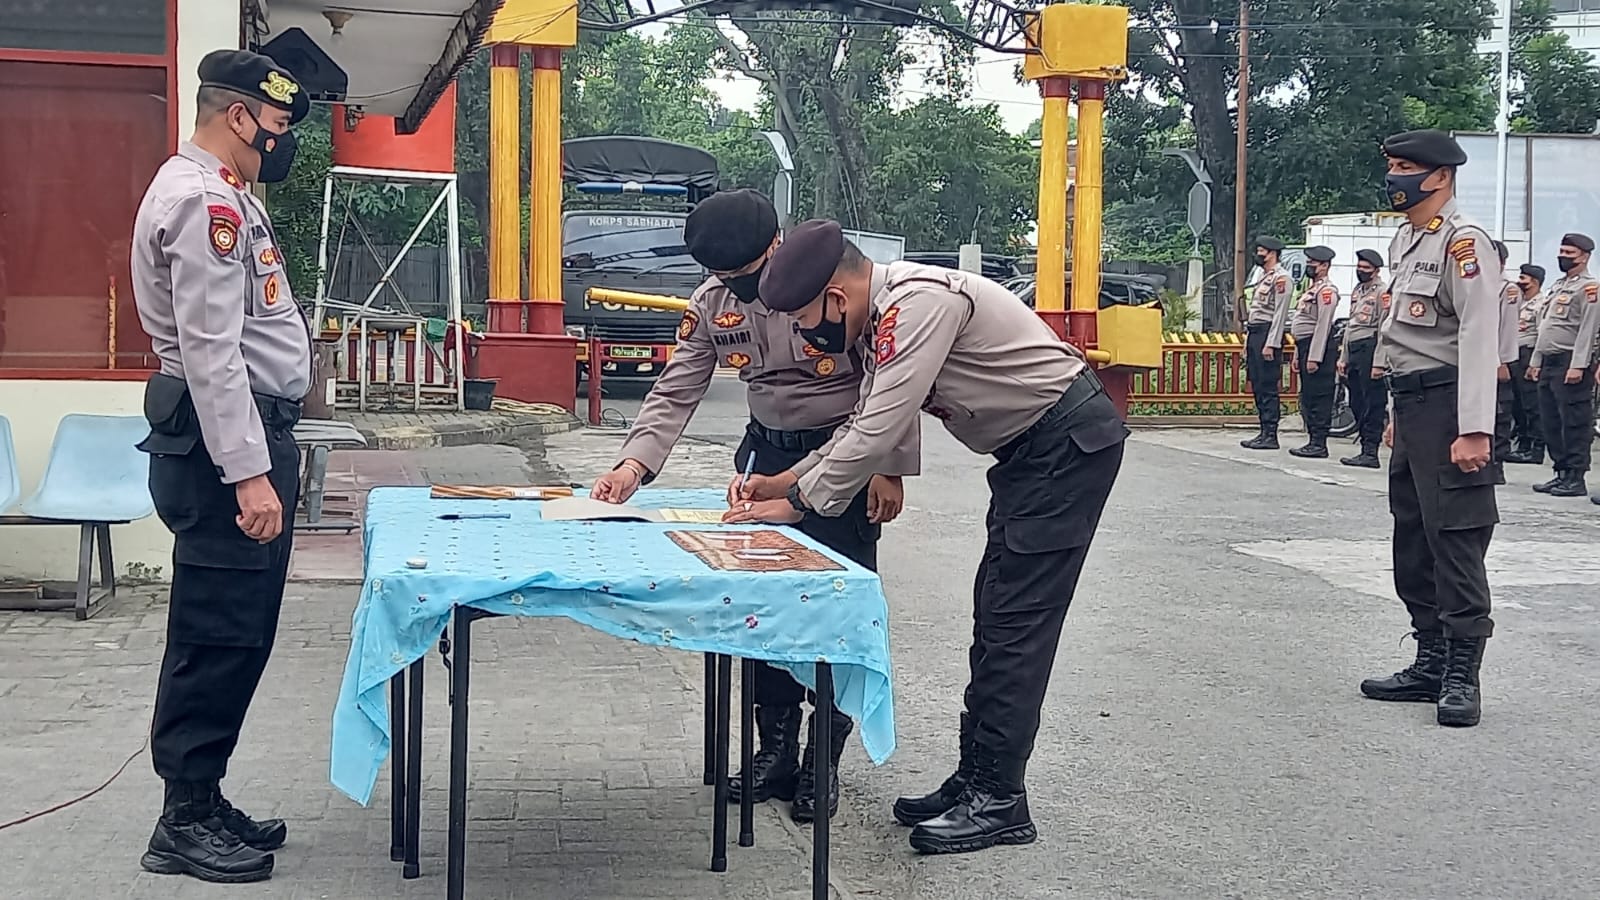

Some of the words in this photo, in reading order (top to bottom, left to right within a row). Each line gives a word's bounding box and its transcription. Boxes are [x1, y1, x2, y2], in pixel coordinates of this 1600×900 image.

[589, 217, 622, 226] KORPS
[1414, 262, 1439, 273] POLRI
[714, 331, 751, 346] KHAIRI
